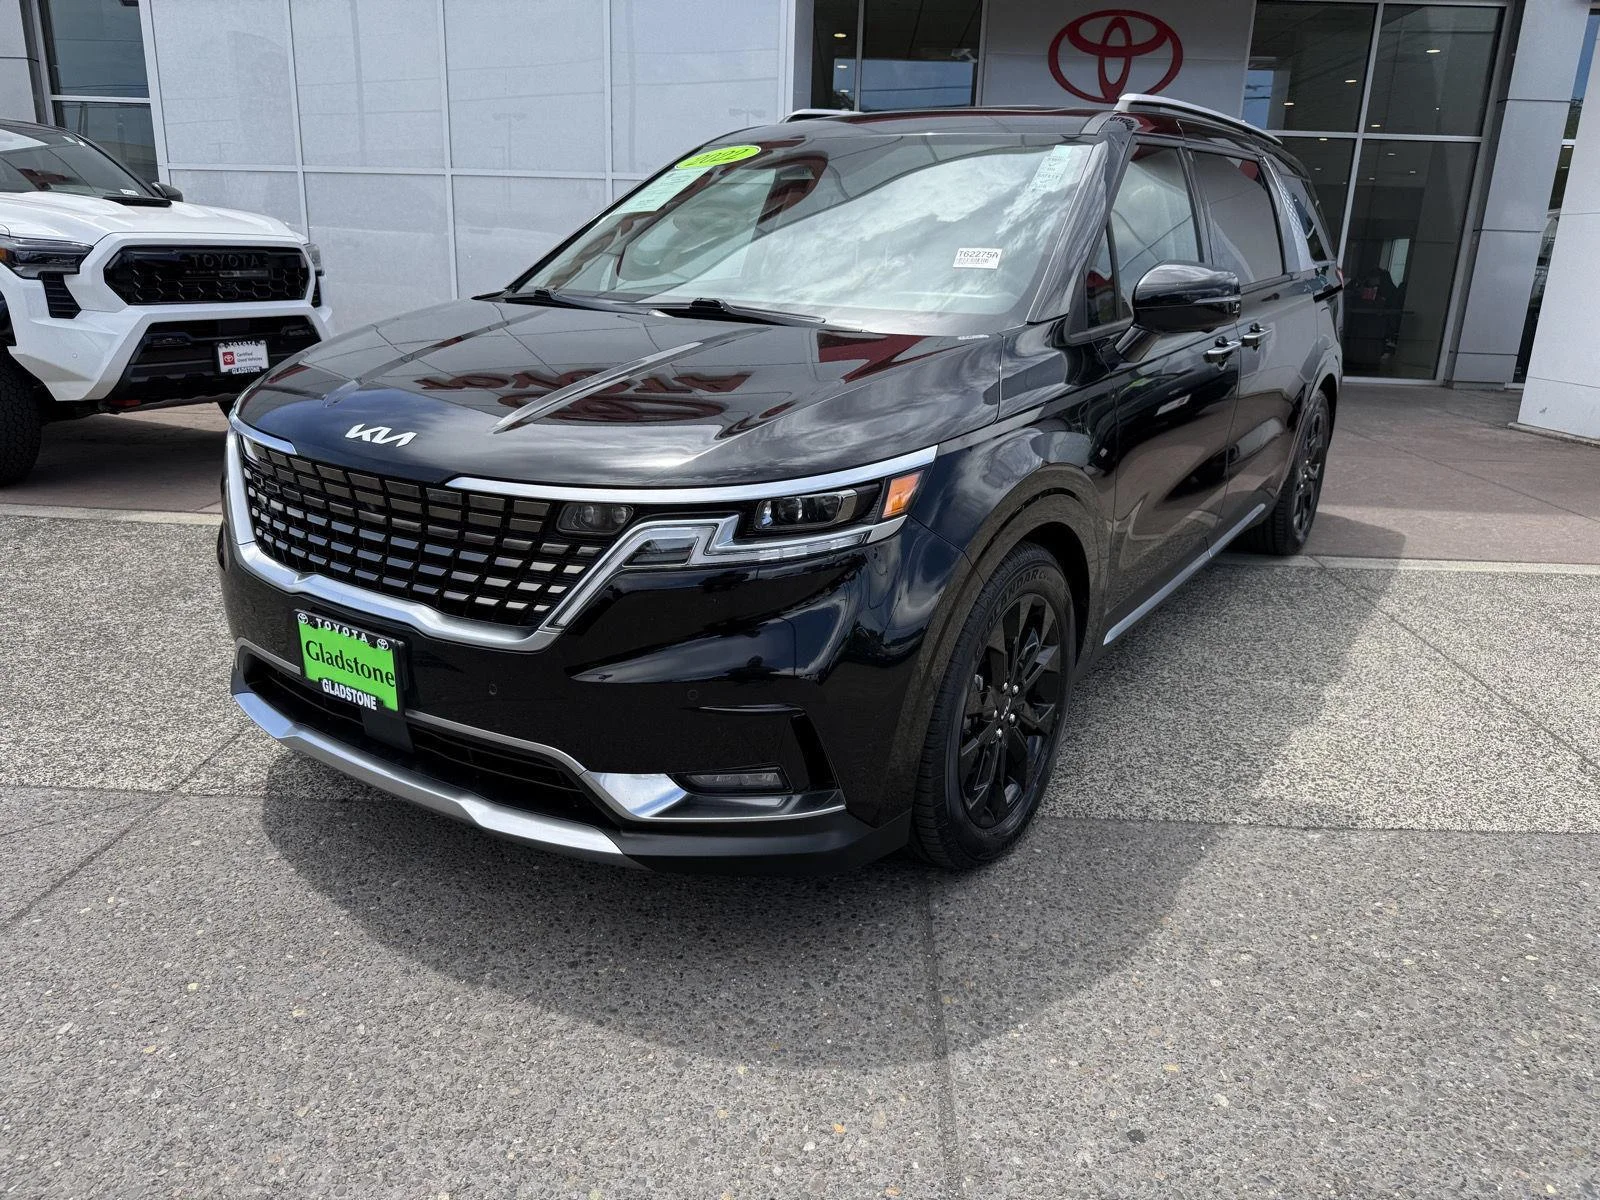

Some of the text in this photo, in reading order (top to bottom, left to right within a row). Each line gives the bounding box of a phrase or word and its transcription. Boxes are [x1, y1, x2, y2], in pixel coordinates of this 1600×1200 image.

[190, 254, 260, 269] TOYOTA
[958, 250, 999, 259] T62275A
[315, 617, 369, 643] TOYOTA
[305, 640, 396, 688] Gladstone
[321, 678, 378, 711] GLADSTONE
